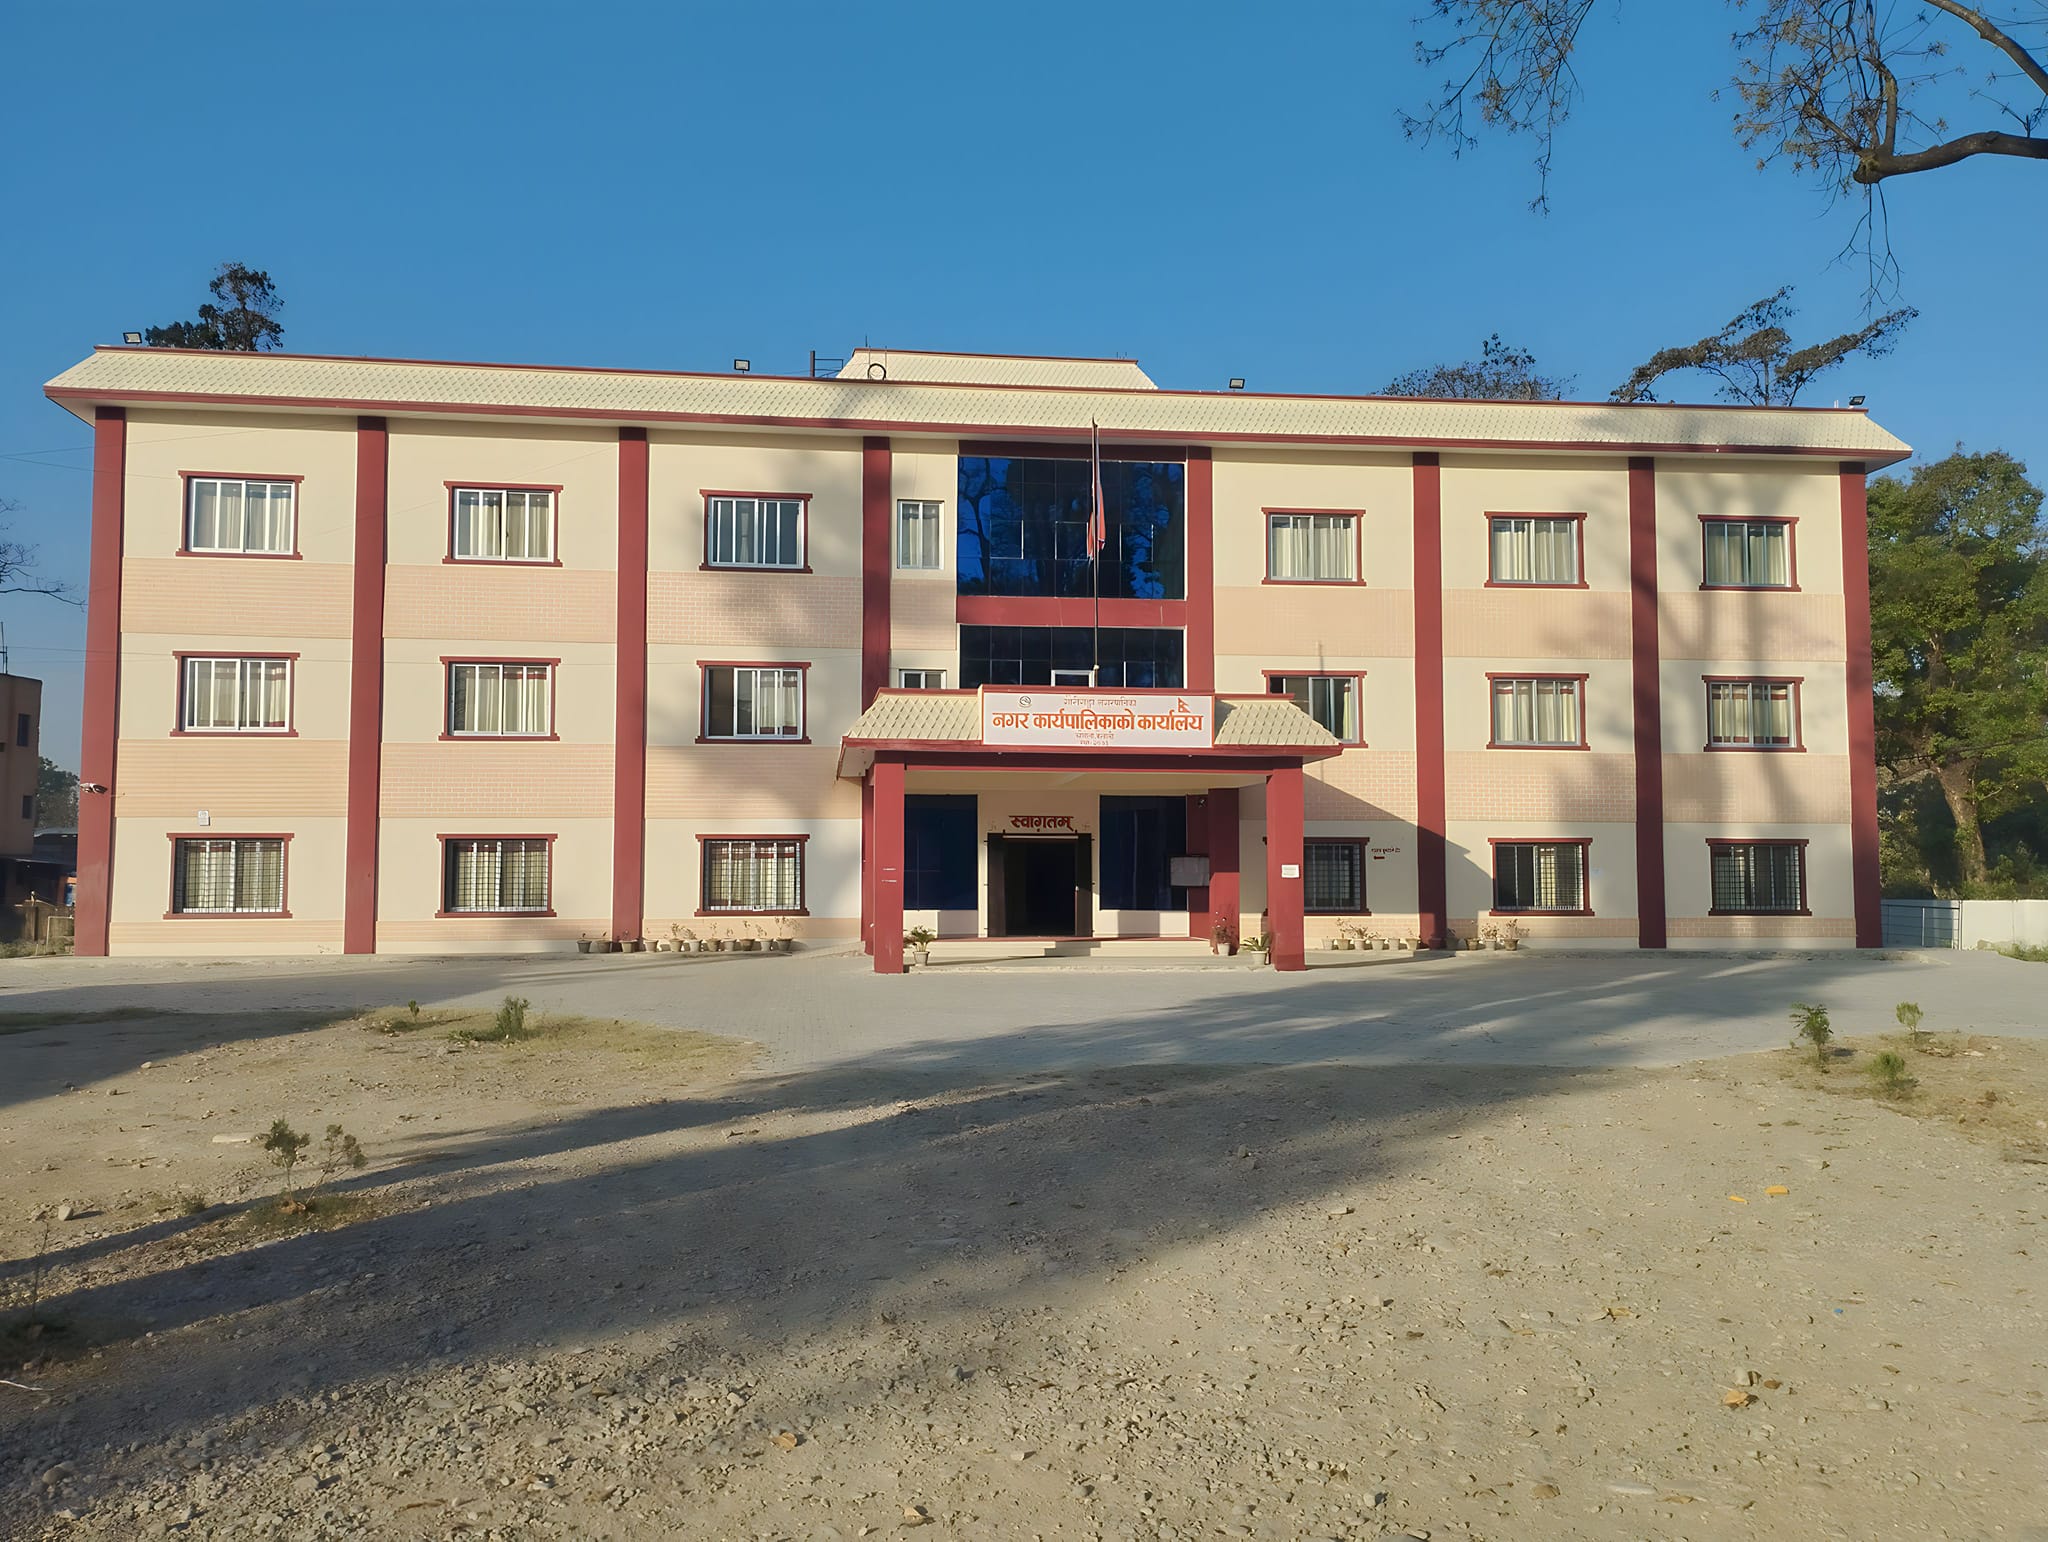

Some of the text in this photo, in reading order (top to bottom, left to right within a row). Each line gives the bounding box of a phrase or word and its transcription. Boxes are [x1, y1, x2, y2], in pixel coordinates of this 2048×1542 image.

[992, 708, 1204, 731] नगर कार्यपालिकाको कार्यालय
[1008, 815, 1075, 832] स्वागतम्
